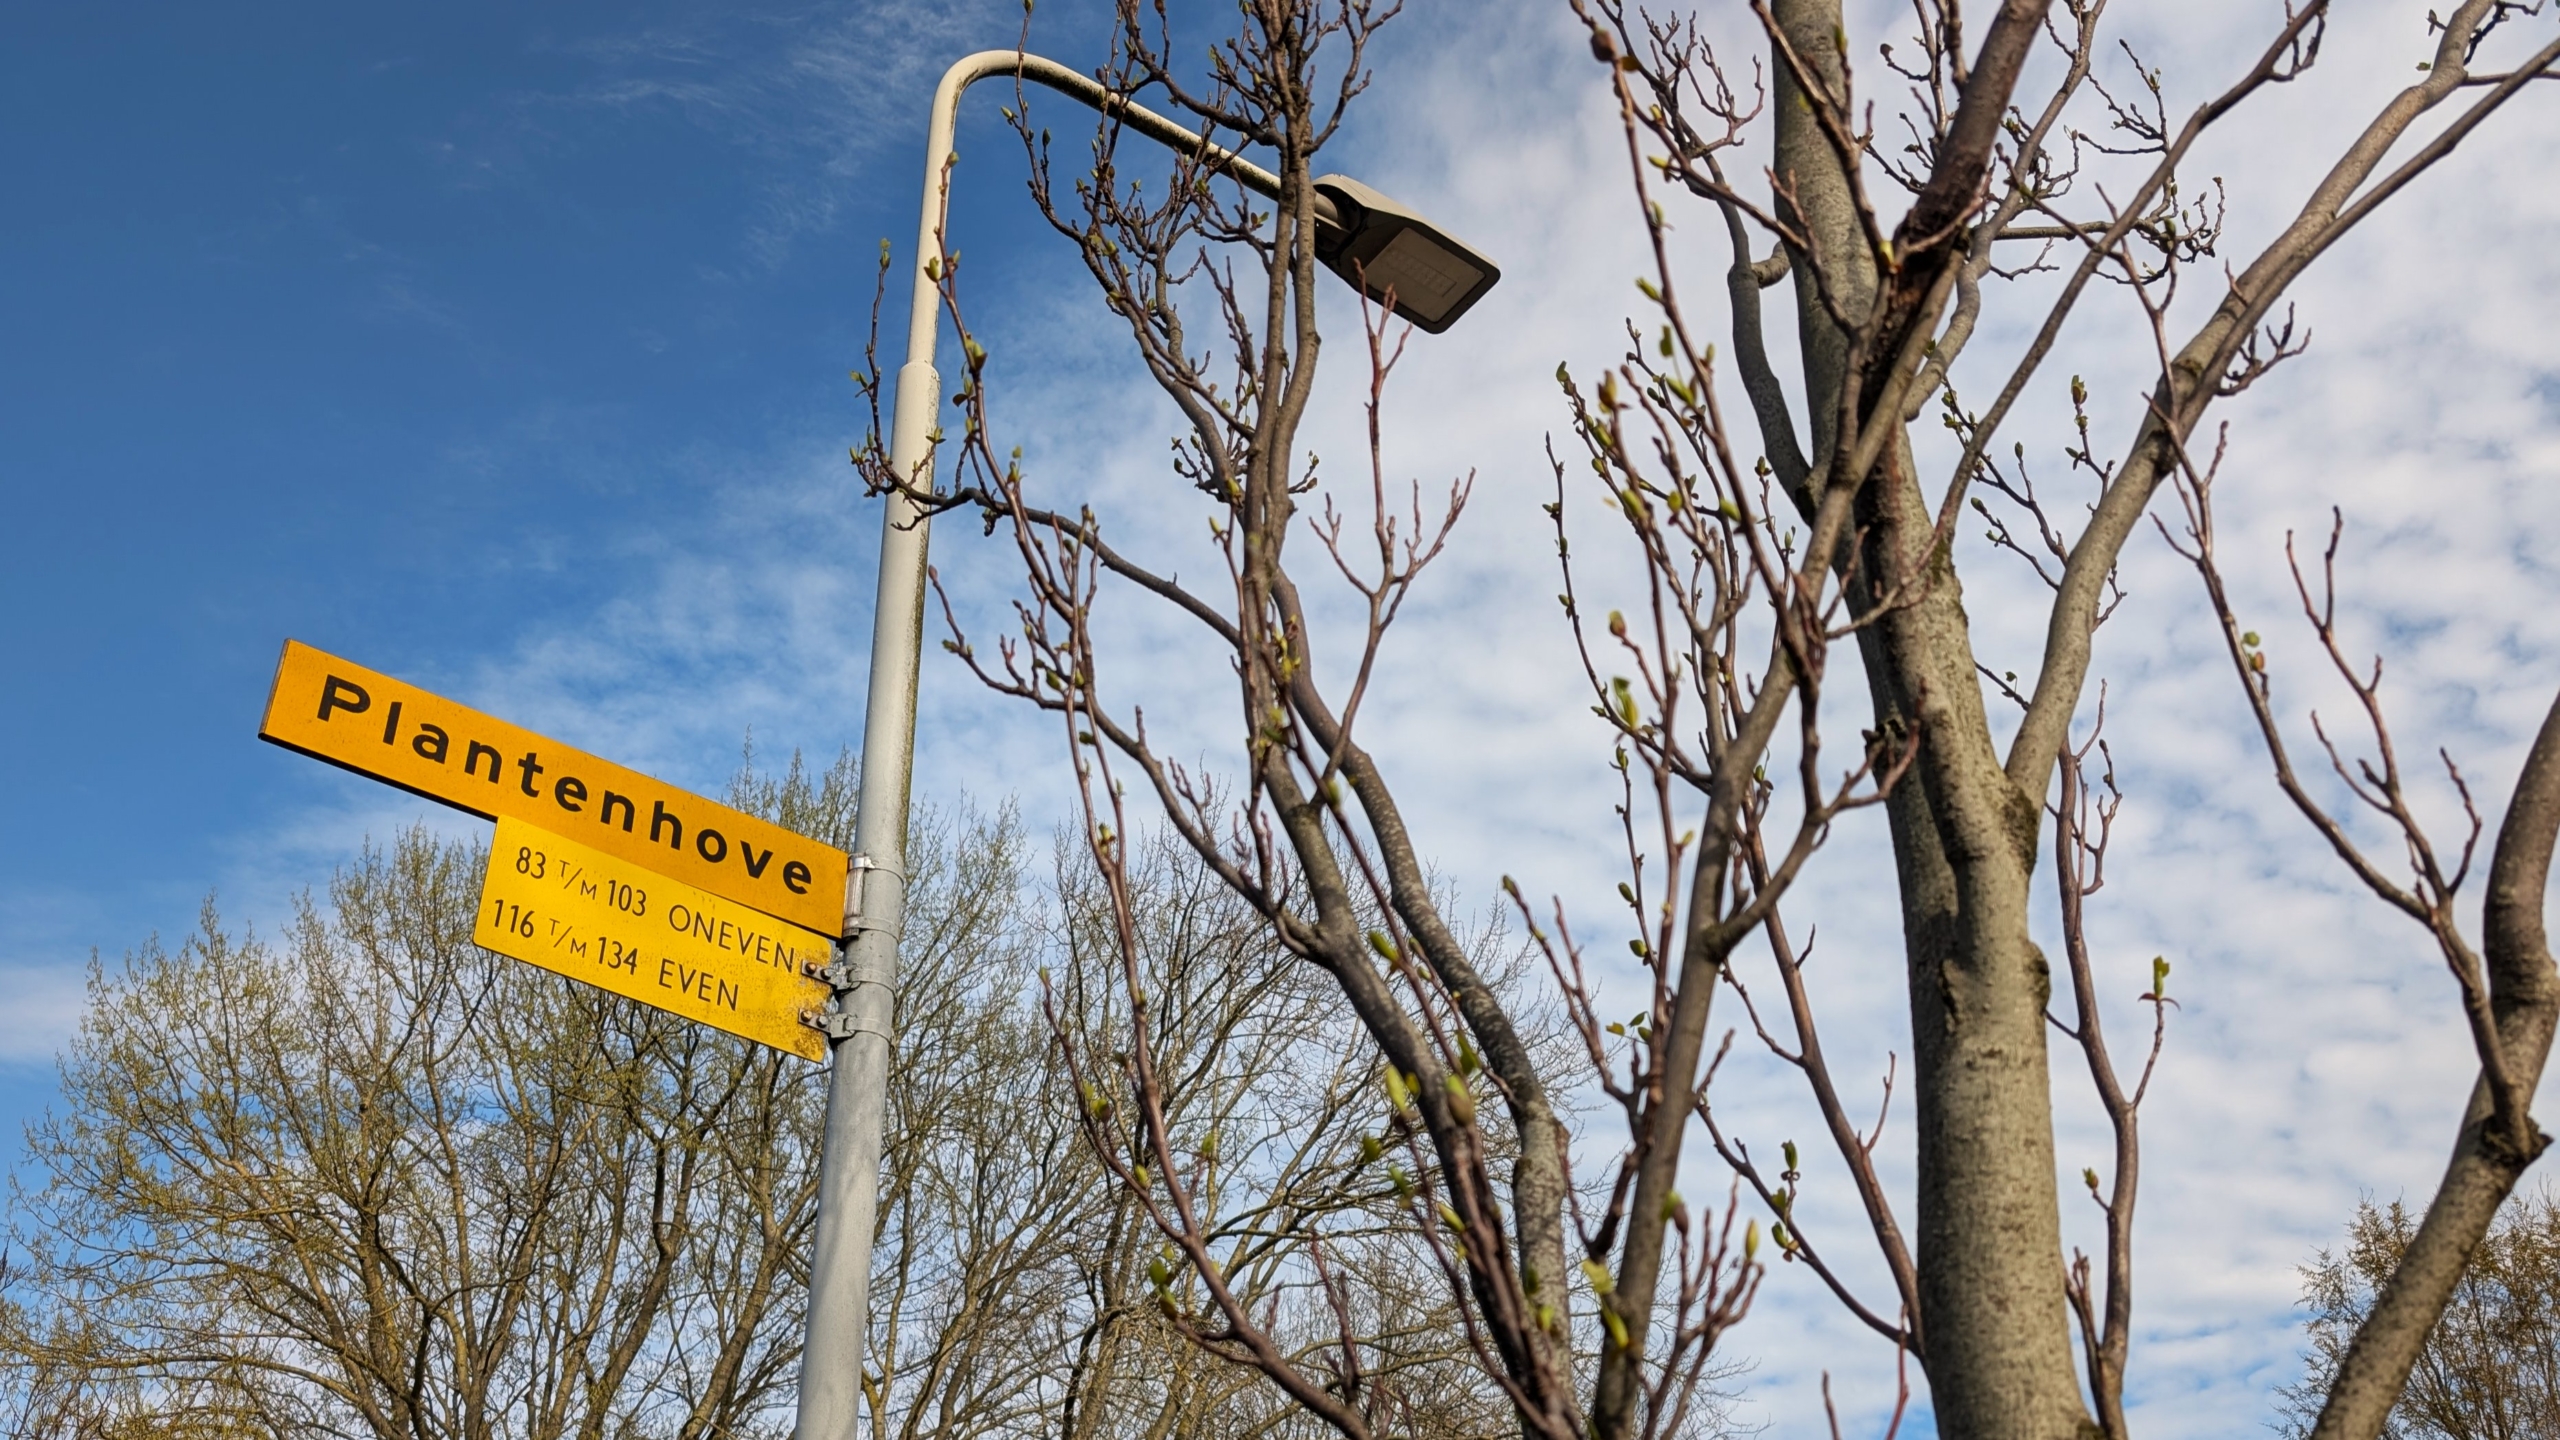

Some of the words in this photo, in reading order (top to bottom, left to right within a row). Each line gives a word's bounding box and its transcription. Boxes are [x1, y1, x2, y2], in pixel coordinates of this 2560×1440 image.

[316, 674, 813, 894] Plantenhove
[493, 899, 534, 938] 116
[549, 918, 587, 958] T/M
[597, 937, 638, 975] 134
[659, 958, 739, 1011] EVEN
[516, 847, 546, 879] 83
[559, 860, 597, 900] T/M
[607, 880, 647, 917] 103
[669, 904, 795, 973] ONEVEN
